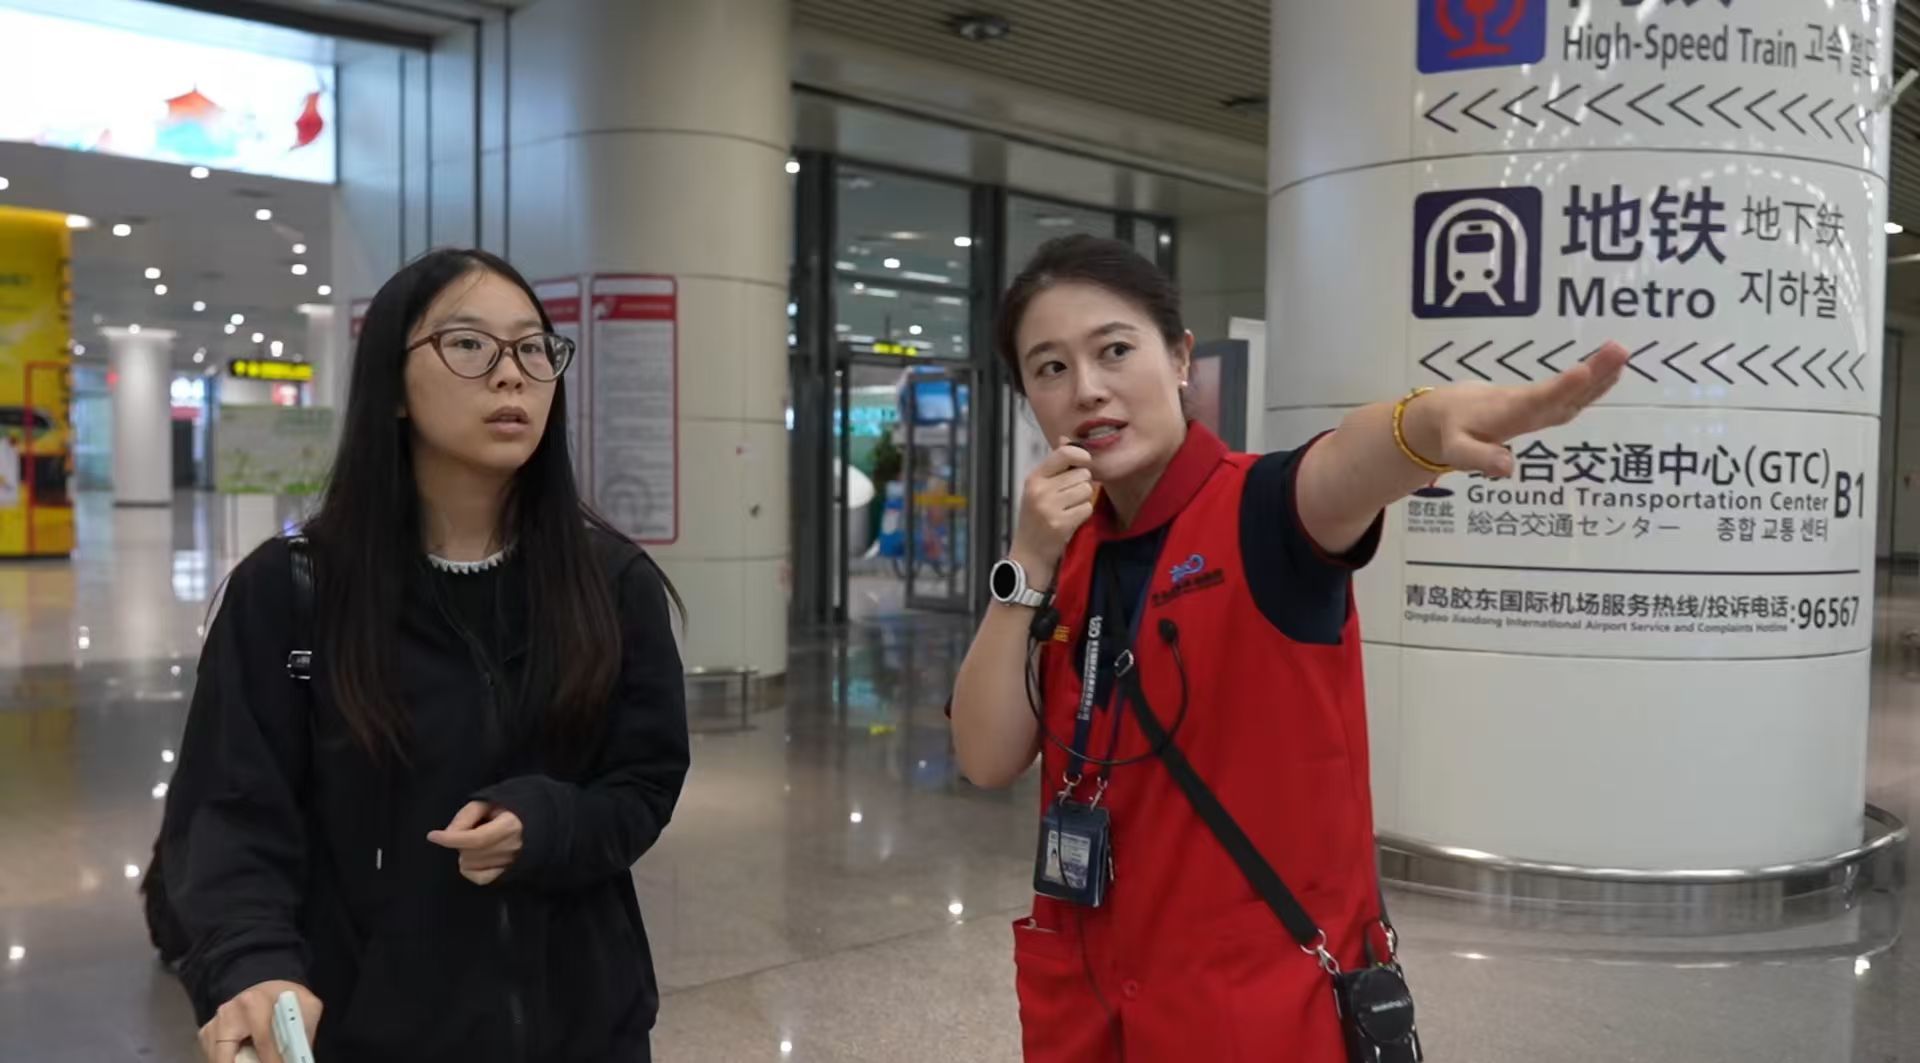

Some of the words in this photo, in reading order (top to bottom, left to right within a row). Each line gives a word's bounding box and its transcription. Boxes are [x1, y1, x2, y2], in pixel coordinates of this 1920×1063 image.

[1562, 22, 1728, 70] High-Speed
[1736, 28, 1797, 68] Train
[1560, 184, 1727, 265] 地铁
[1557, 277, 1716, 319] Metro
[1739, 268, 1837, 319] 지하철
[1468, 440, 1831, 488] 合交通中心(GTC)
[1467, 484, 1564, 506] Ground
[1576, 487, 1762, 513] Transportation
[1770, 491, 1829, 511] Center
[1833, 470, 1864, 519] B1
[1467, 509, 1681, 538] 総合交通センター
[1716, 516, 1756, 543] 종합
[1761, 516, 1796, 543] 교통
[1800, 516, 1829, 543] 센터
[1506, 616, 1581, 630] International
[1585, 619, 1627, 633] Airport
[1631, 622, 1671, 633] Service
[1674, 622, 1695, 633] and
[1698, 622, 1753, 634] Complaints
